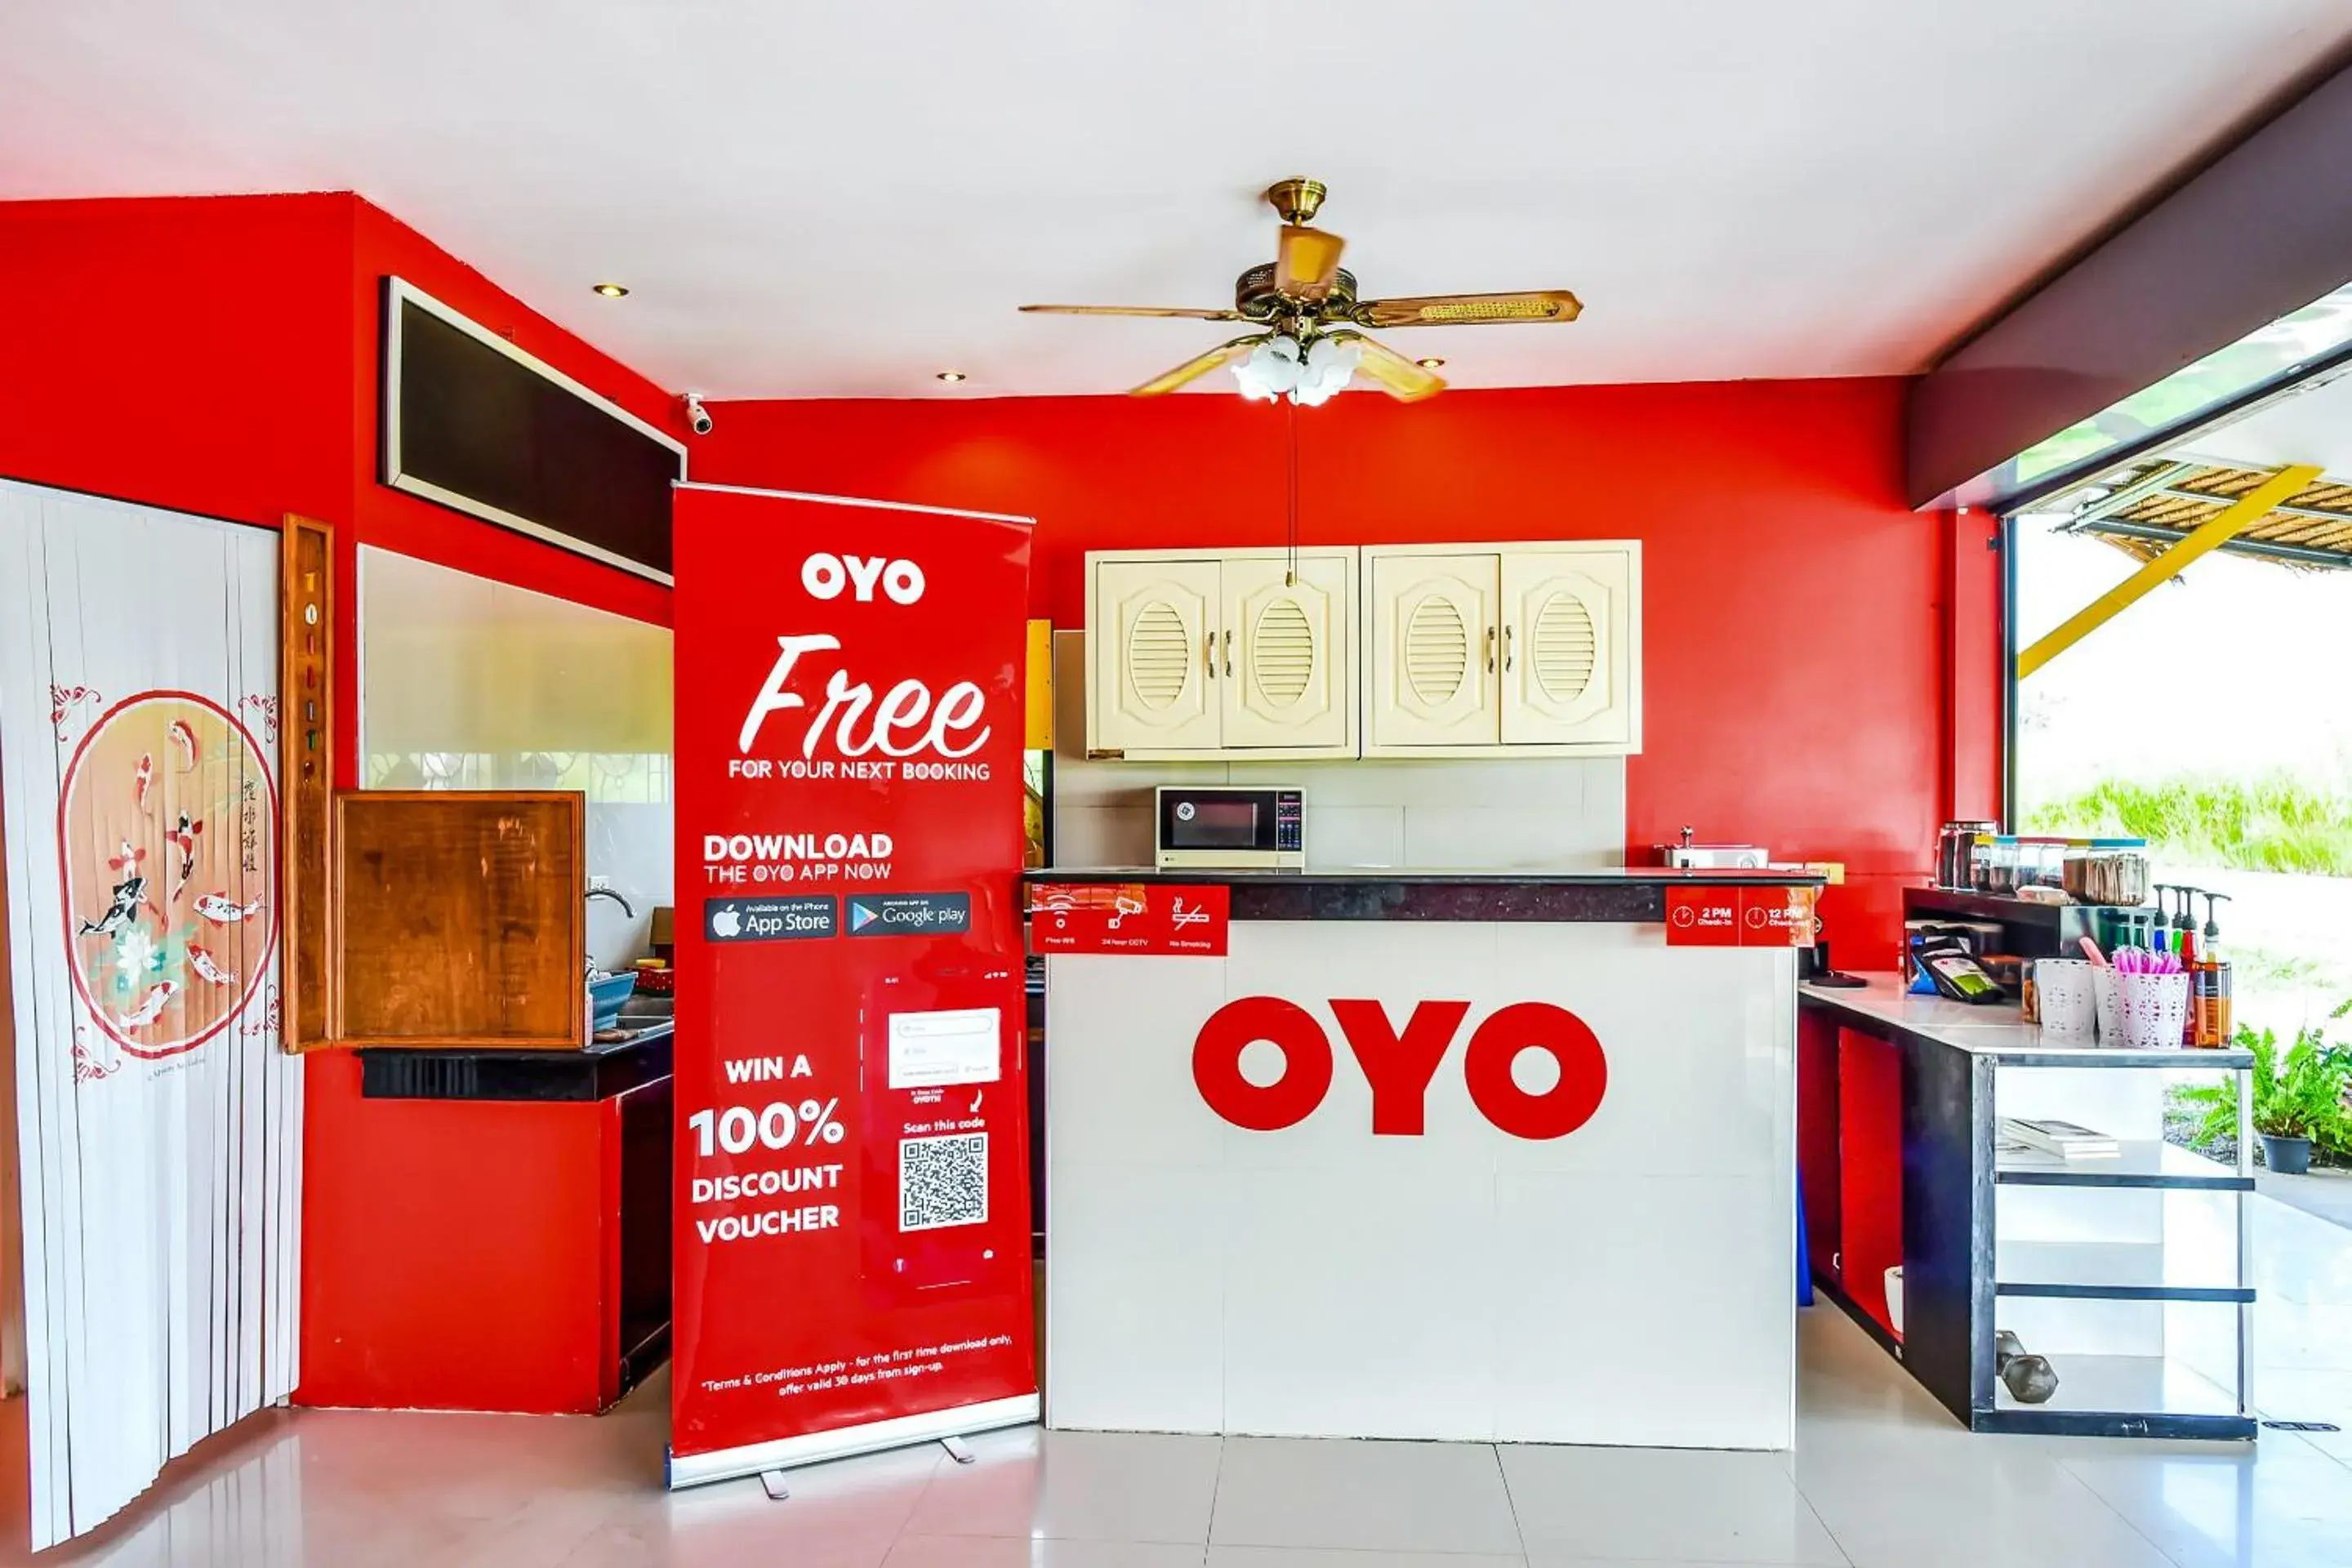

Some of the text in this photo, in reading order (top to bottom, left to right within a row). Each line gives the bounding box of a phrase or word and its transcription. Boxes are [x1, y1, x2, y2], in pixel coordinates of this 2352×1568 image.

[800, 552, 926, 605] OYO
[738, 633, 991, 760] Free
[728, 760, 991, 781] FOR YOUR NEXT BOOKING
[704, 833, 893, 862] DOWNLOAD
[703, 862, 892, 884] THE OYO APP NOW
[791, 902, 803, 911] the
[882, 906, 966, 928] Google play
[1702, 907, 1732, 918] 2 PM
[1768, 908, 1804, 919] 12 PM
[745, 913, 831, 936] App Store
[724, 1054, 813, 1085] WIN A
[1192, 996, 1607, 1140] OYO
[688, 1097, 844, 1157] 100%
[903, 1116, 986, 1134] Scan this code
[692, 1164, 843, 1204] DISCOUNT
[696, 1205, 840, 1244] VOUCHER
[742, 1374, 752, 1386] &
[755, 1367, 813, 1383] Conditions
[815, 1361, 846, 1375] Apply
[855, 1356, 871, 1367] for
[872, 1353, 890, 1365] the
[893, 1349, 914, 1361] first
[915, 1347, 938, 1357] time
[939, 1337, 988, 1354] download
[778, 1382, 804, 1396] offer
[806, 1377, 832, 1392] valid
[834, 1374, 849, 1388] 30
[850, 1372, 876, 1384] days
[876, 1368, 902, 1380] from
